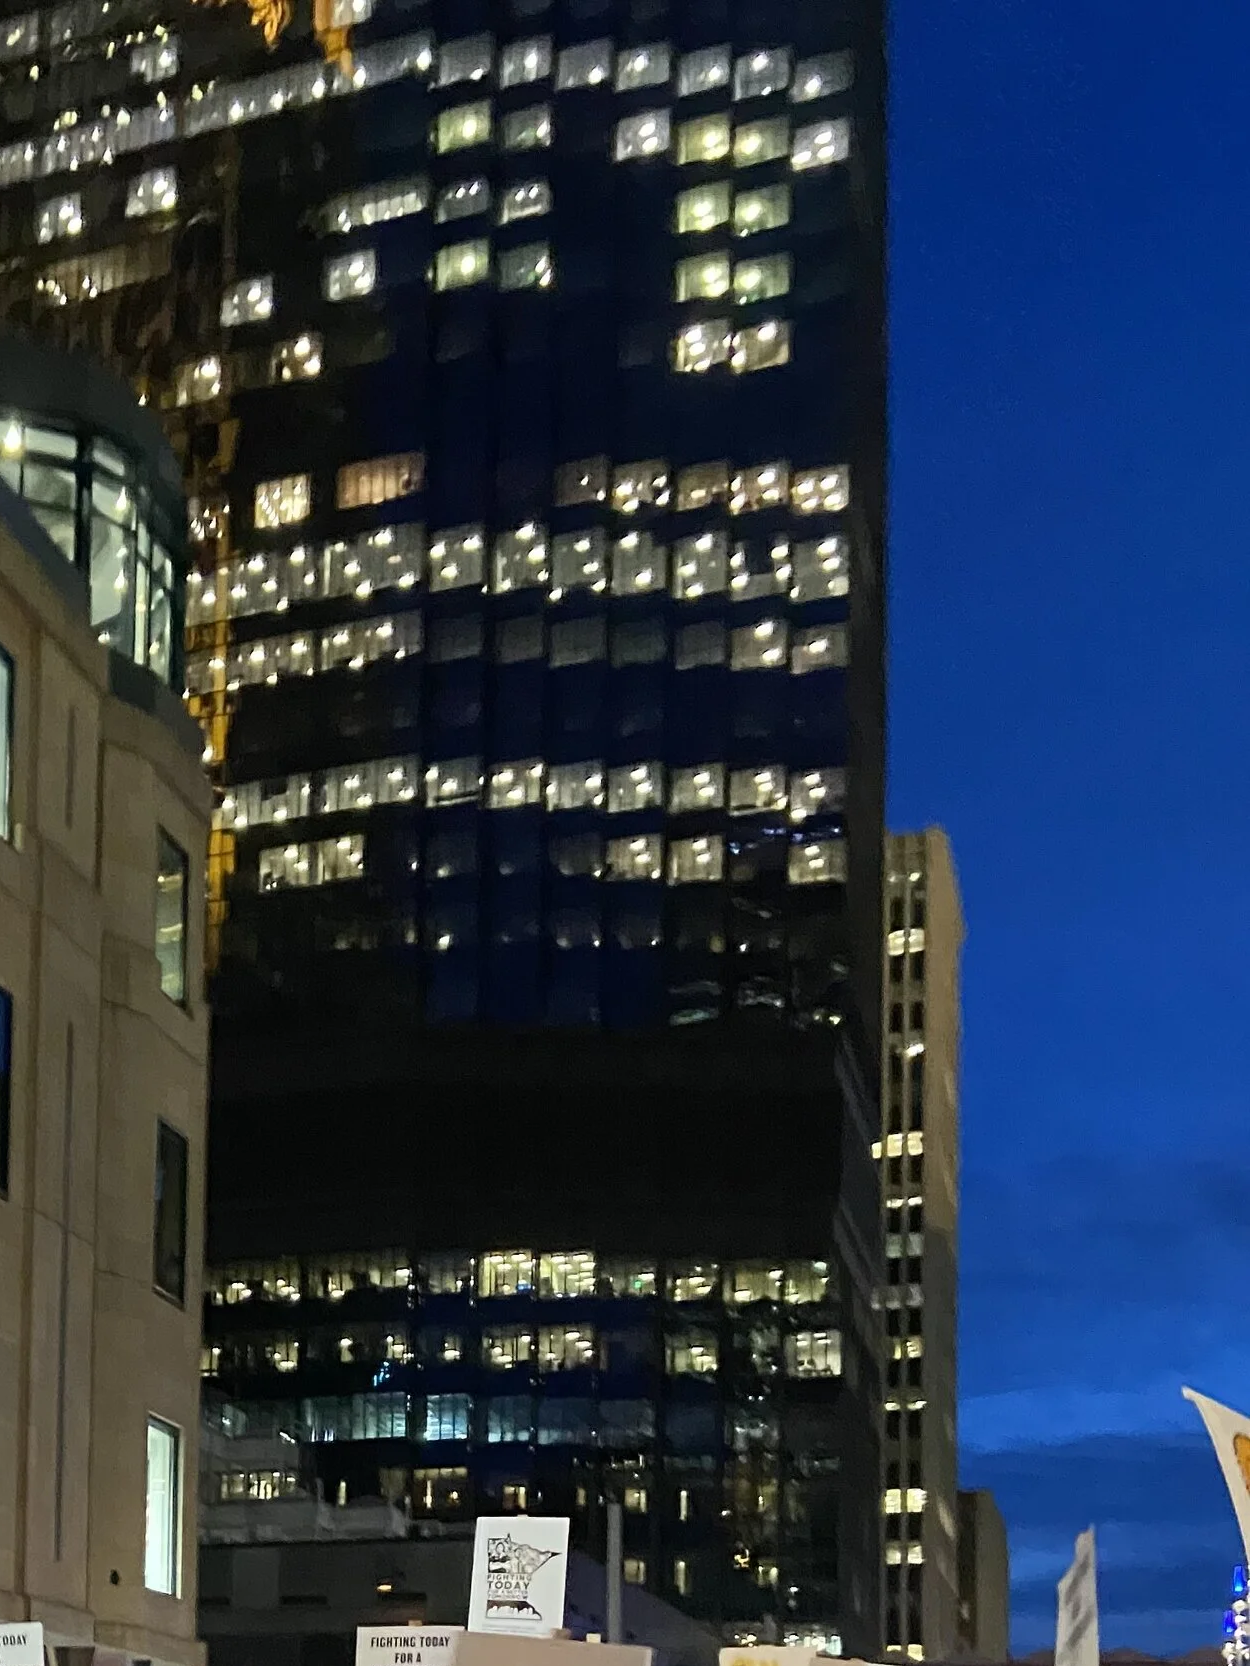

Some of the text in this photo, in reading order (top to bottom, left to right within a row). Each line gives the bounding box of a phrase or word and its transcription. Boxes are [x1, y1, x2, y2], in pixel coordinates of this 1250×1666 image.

[487, 1581, 529, 1589] TODAY
[371, 1636, 450, 1647] FIGHTING TODAY
[395, 1653, 422, 1664] FOR A
